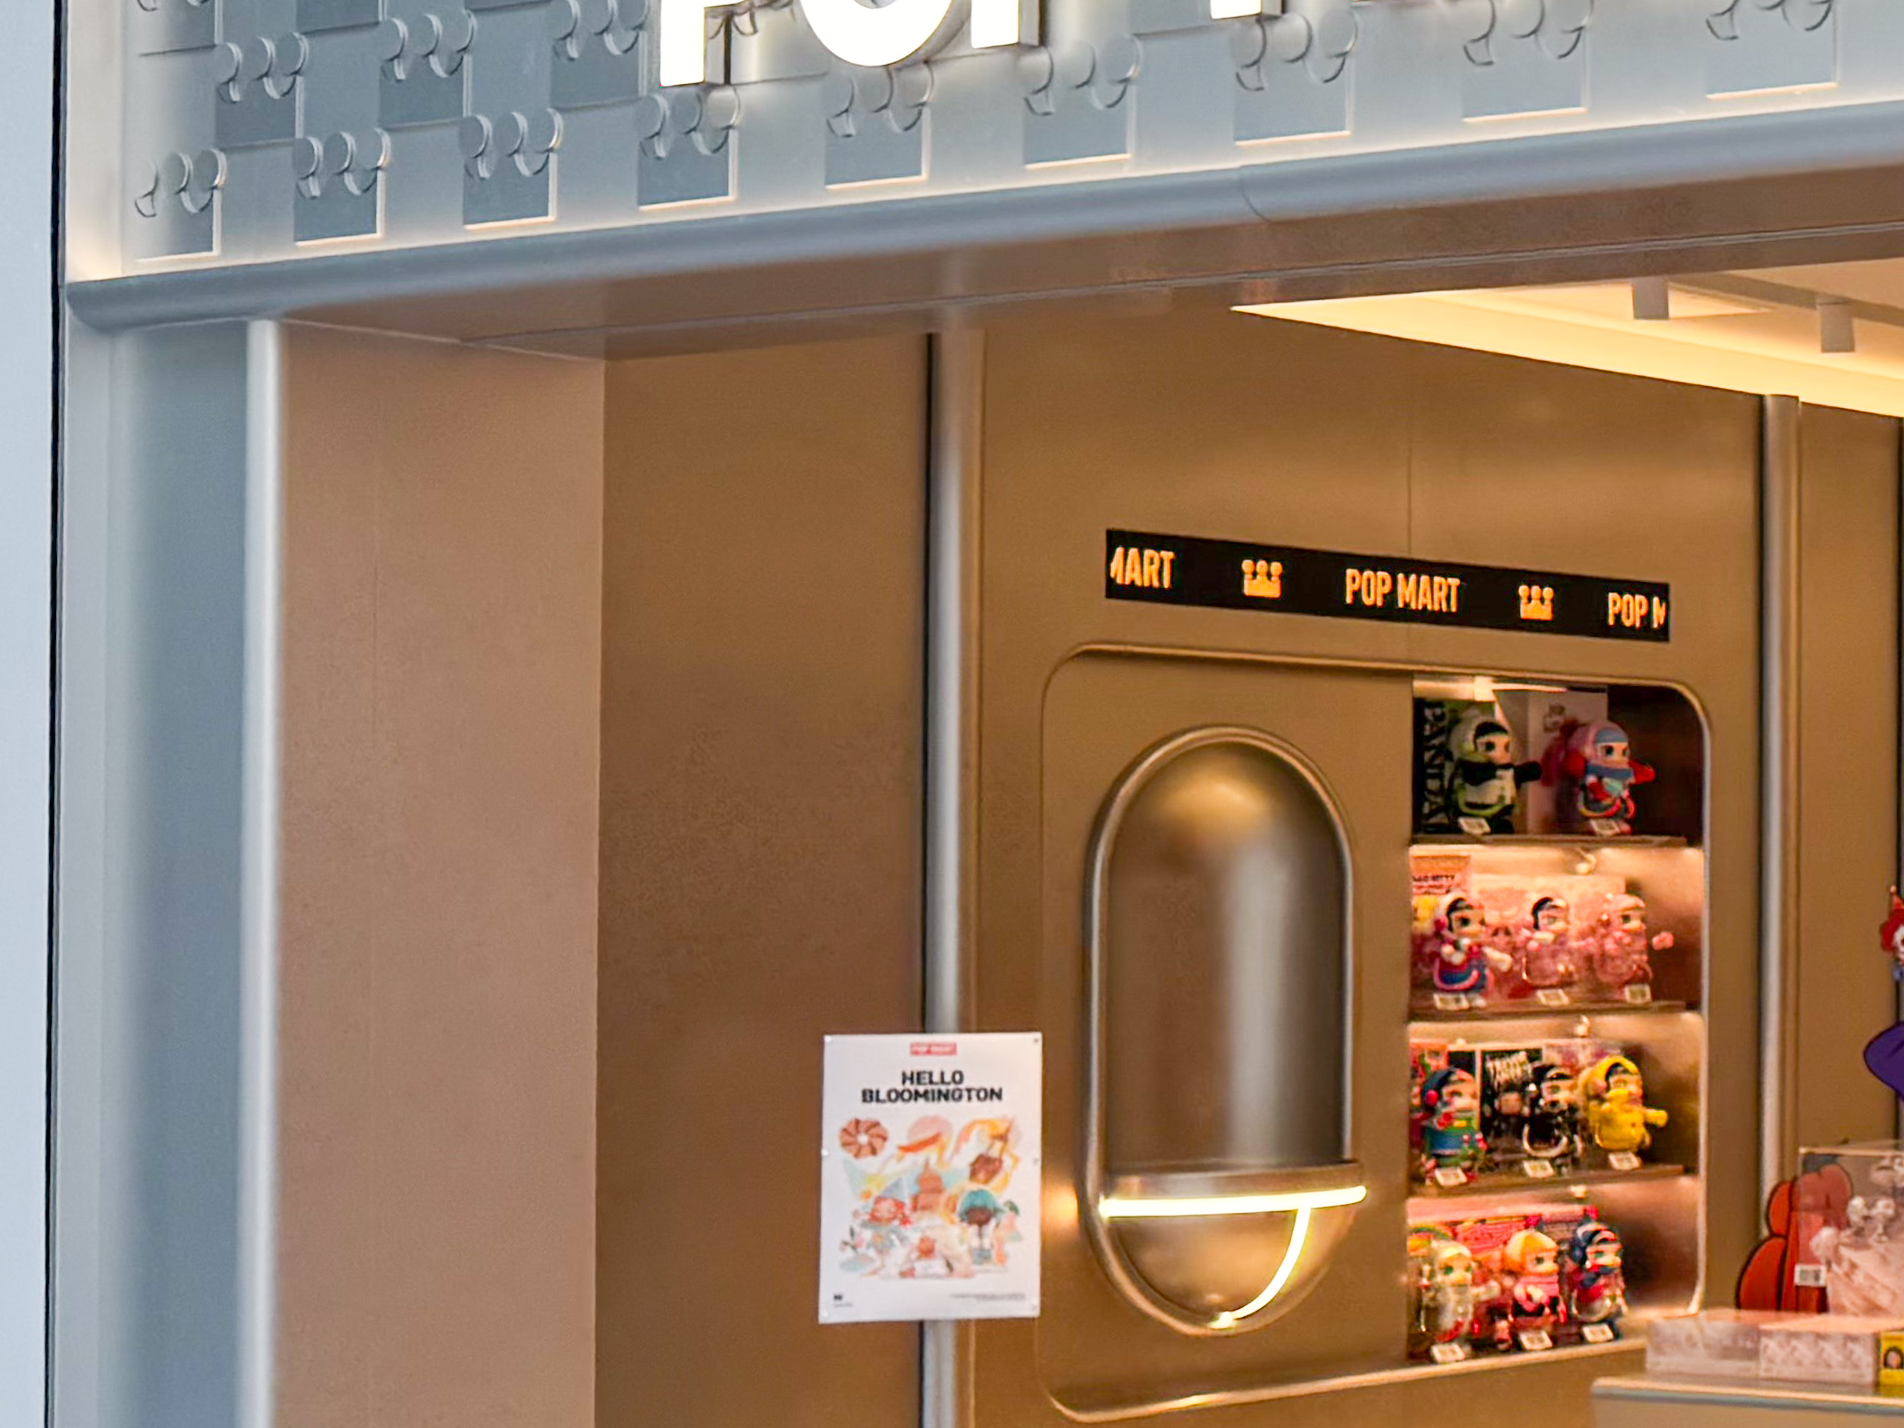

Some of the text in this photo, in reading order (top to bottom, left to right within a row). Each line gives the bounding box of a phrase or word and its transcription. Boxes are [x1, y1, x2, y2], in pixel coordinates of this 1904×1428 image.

[1345, 568, 1392, 606] POP
[1397, 573, 1460, 614] MART
[1608, 592, 1648, 628] POP
[901, 1070, 964, 1086] HELLO
[860, 1087, 1003, 1104] BLOOMINGTON
